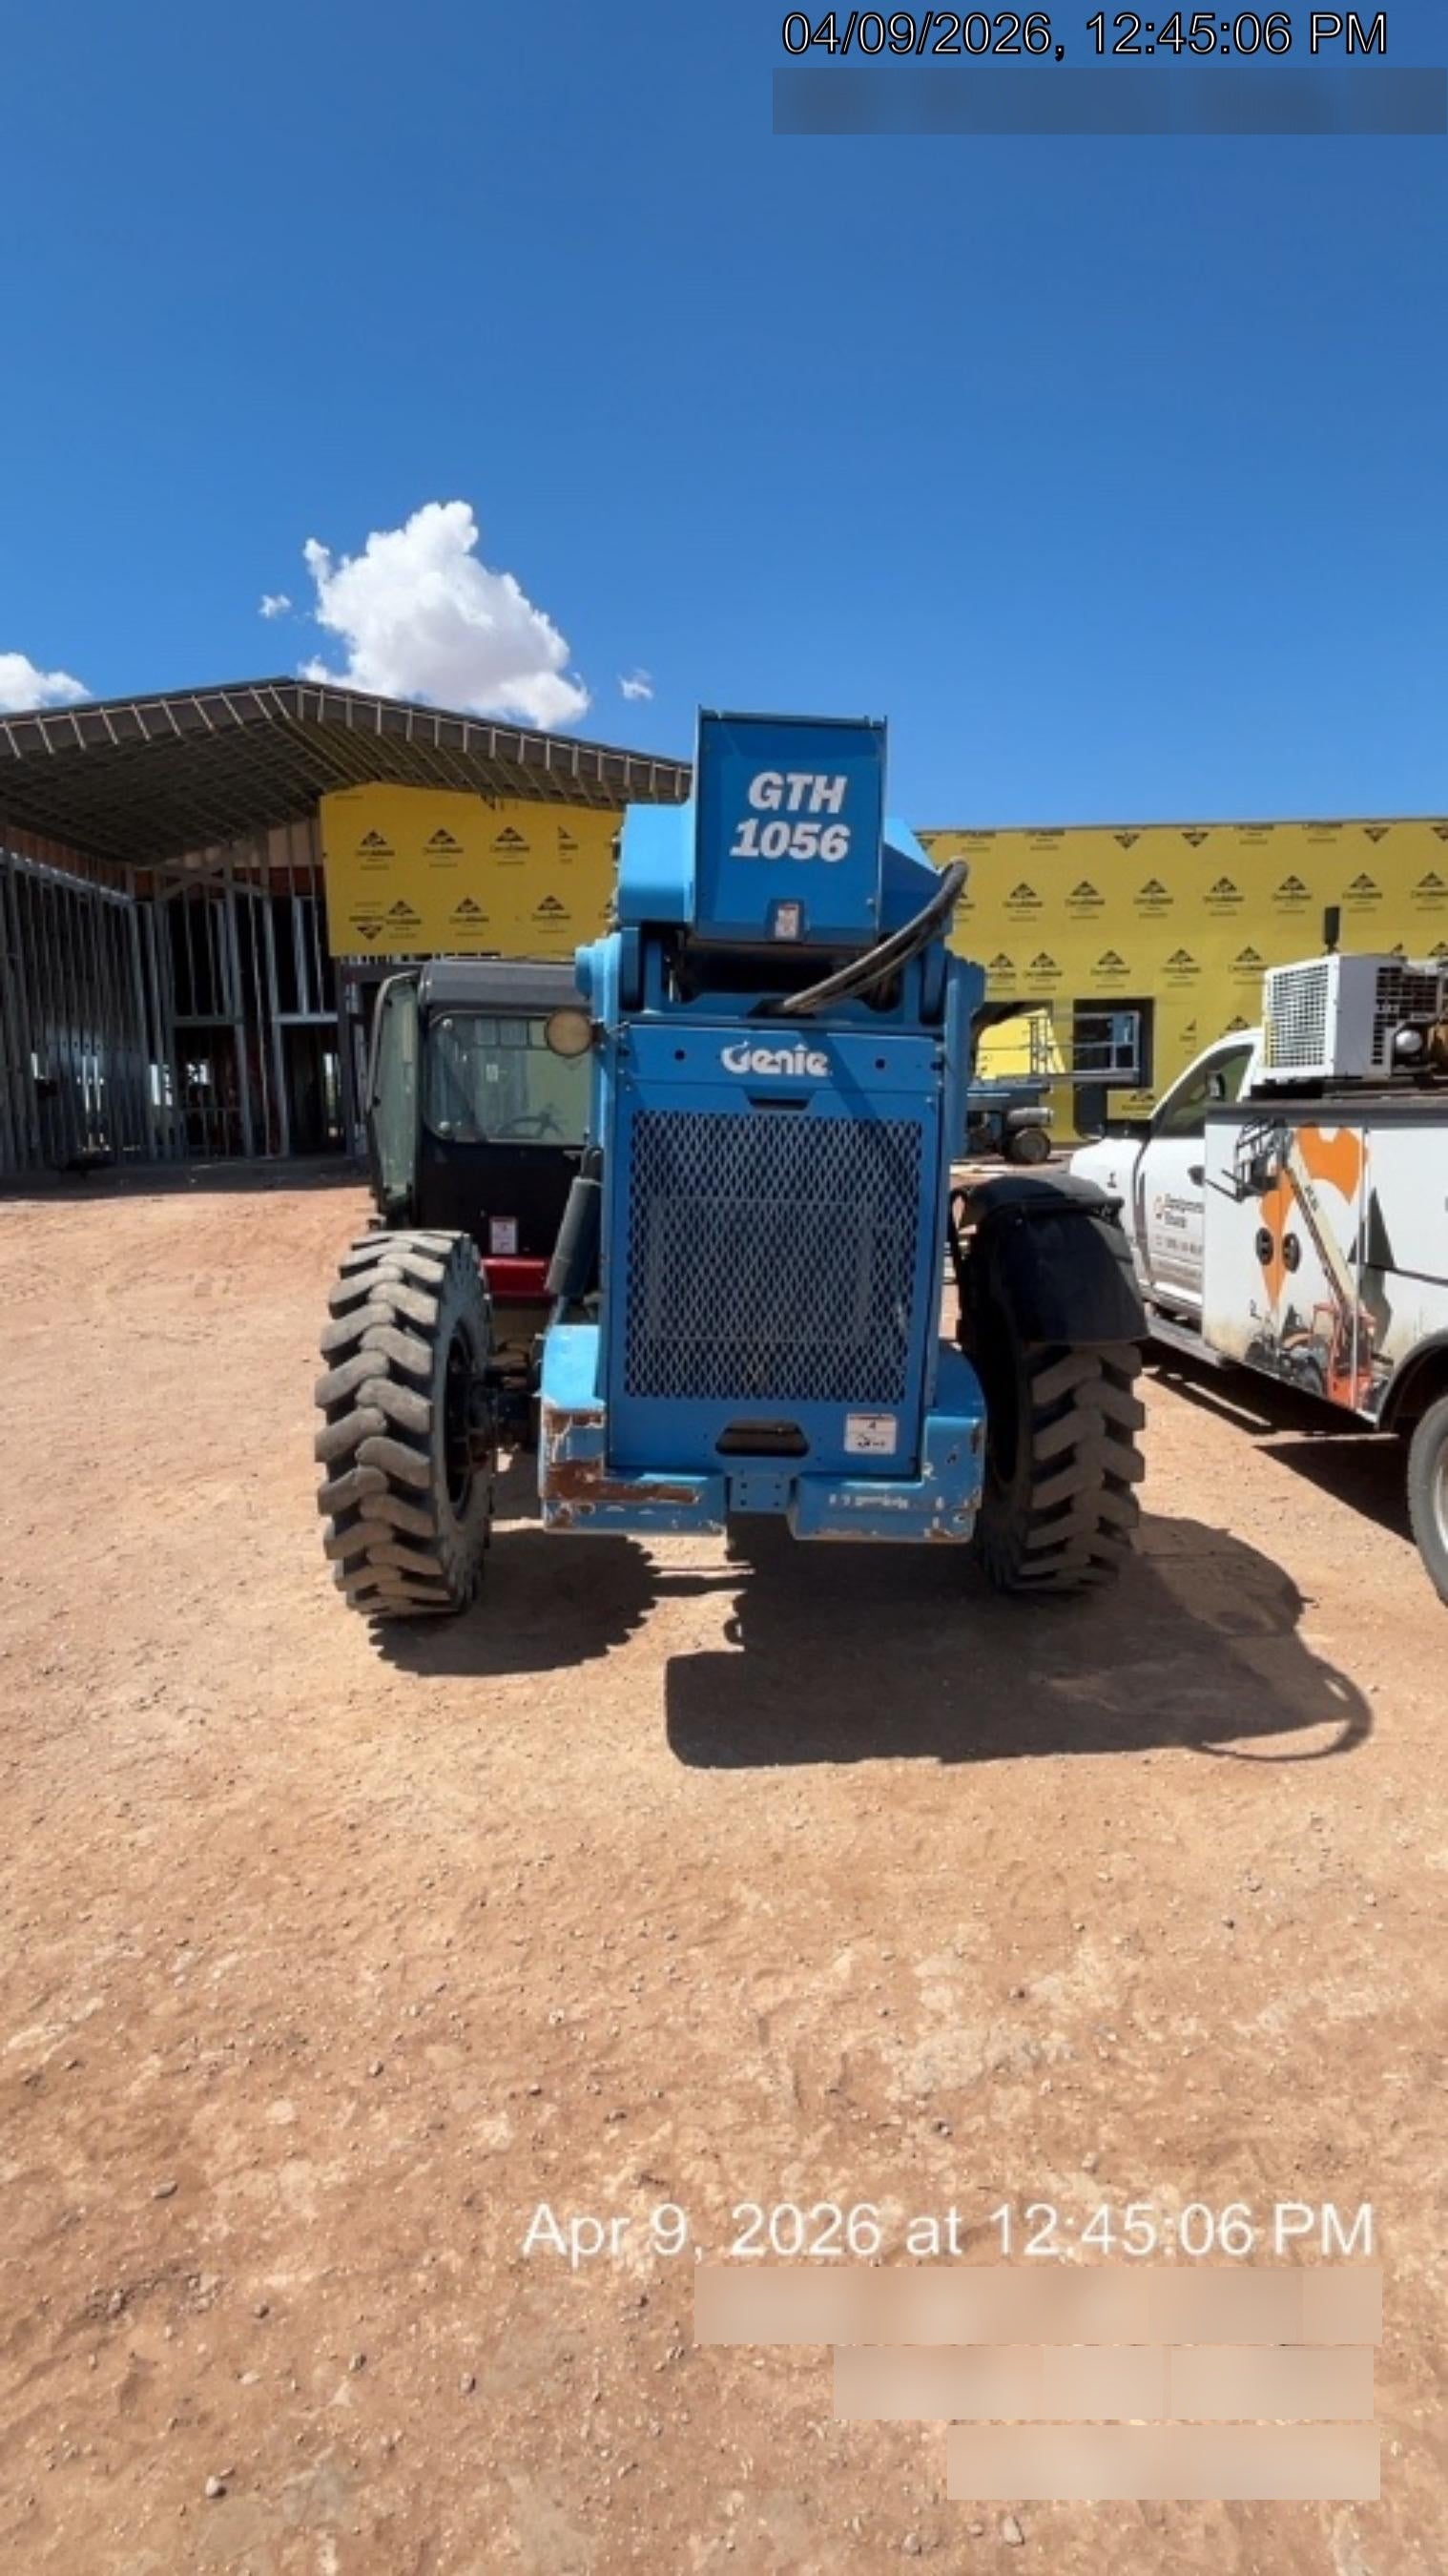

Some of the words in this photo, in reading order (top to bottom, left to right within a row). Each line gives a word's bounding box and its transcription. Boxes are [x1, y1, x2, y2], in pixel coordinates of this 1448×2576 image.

[748, 771, 848, 814] GTH
[729, 818, 851, 862] 1056
[720, 1040, 828, 1077] Genie
